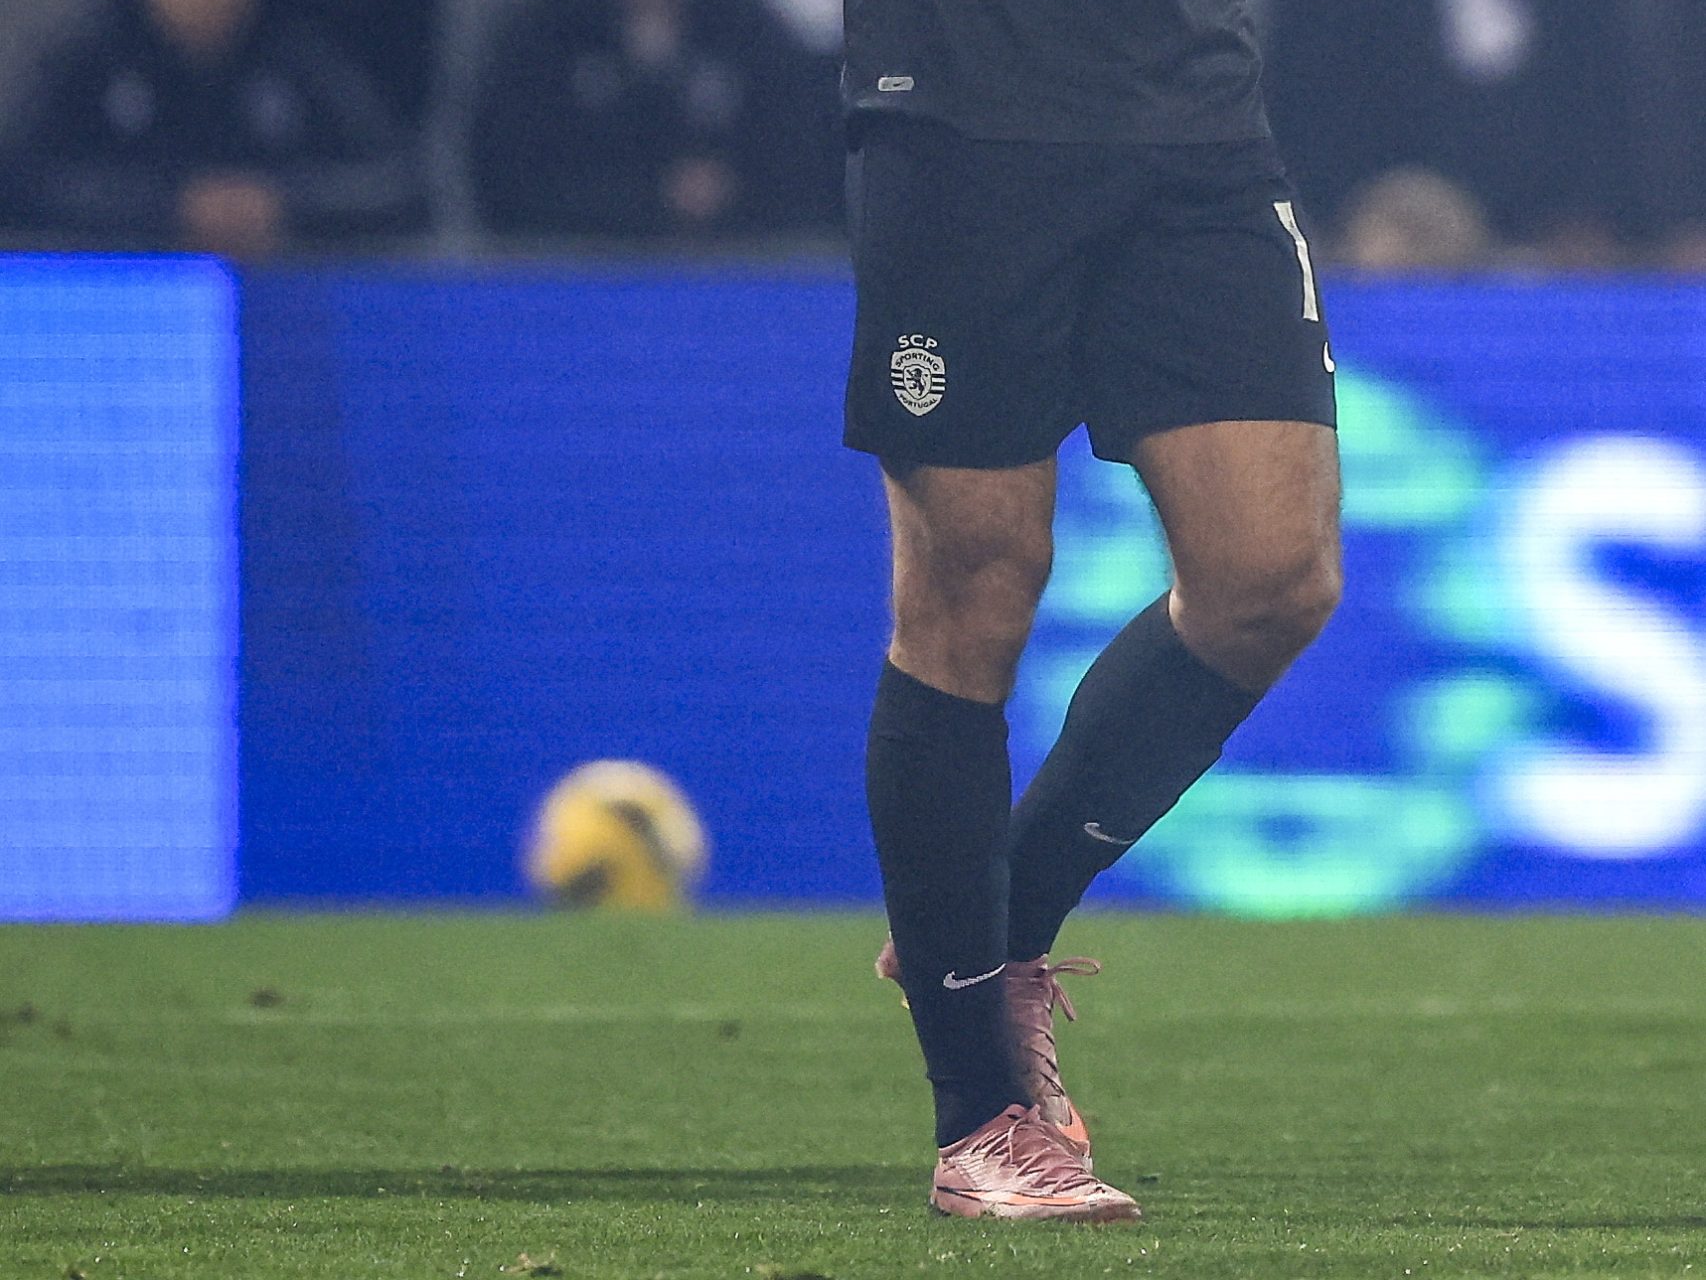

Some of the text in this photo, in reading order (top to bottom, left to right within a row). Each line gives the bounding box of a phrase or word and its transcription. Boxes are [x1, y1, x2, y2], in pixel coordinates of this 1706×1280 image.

[898, 334, 938, 349] SCP
[895, 352, 940, 371] SPORTING
[900, 393, 938, 409] PORTUGAL
